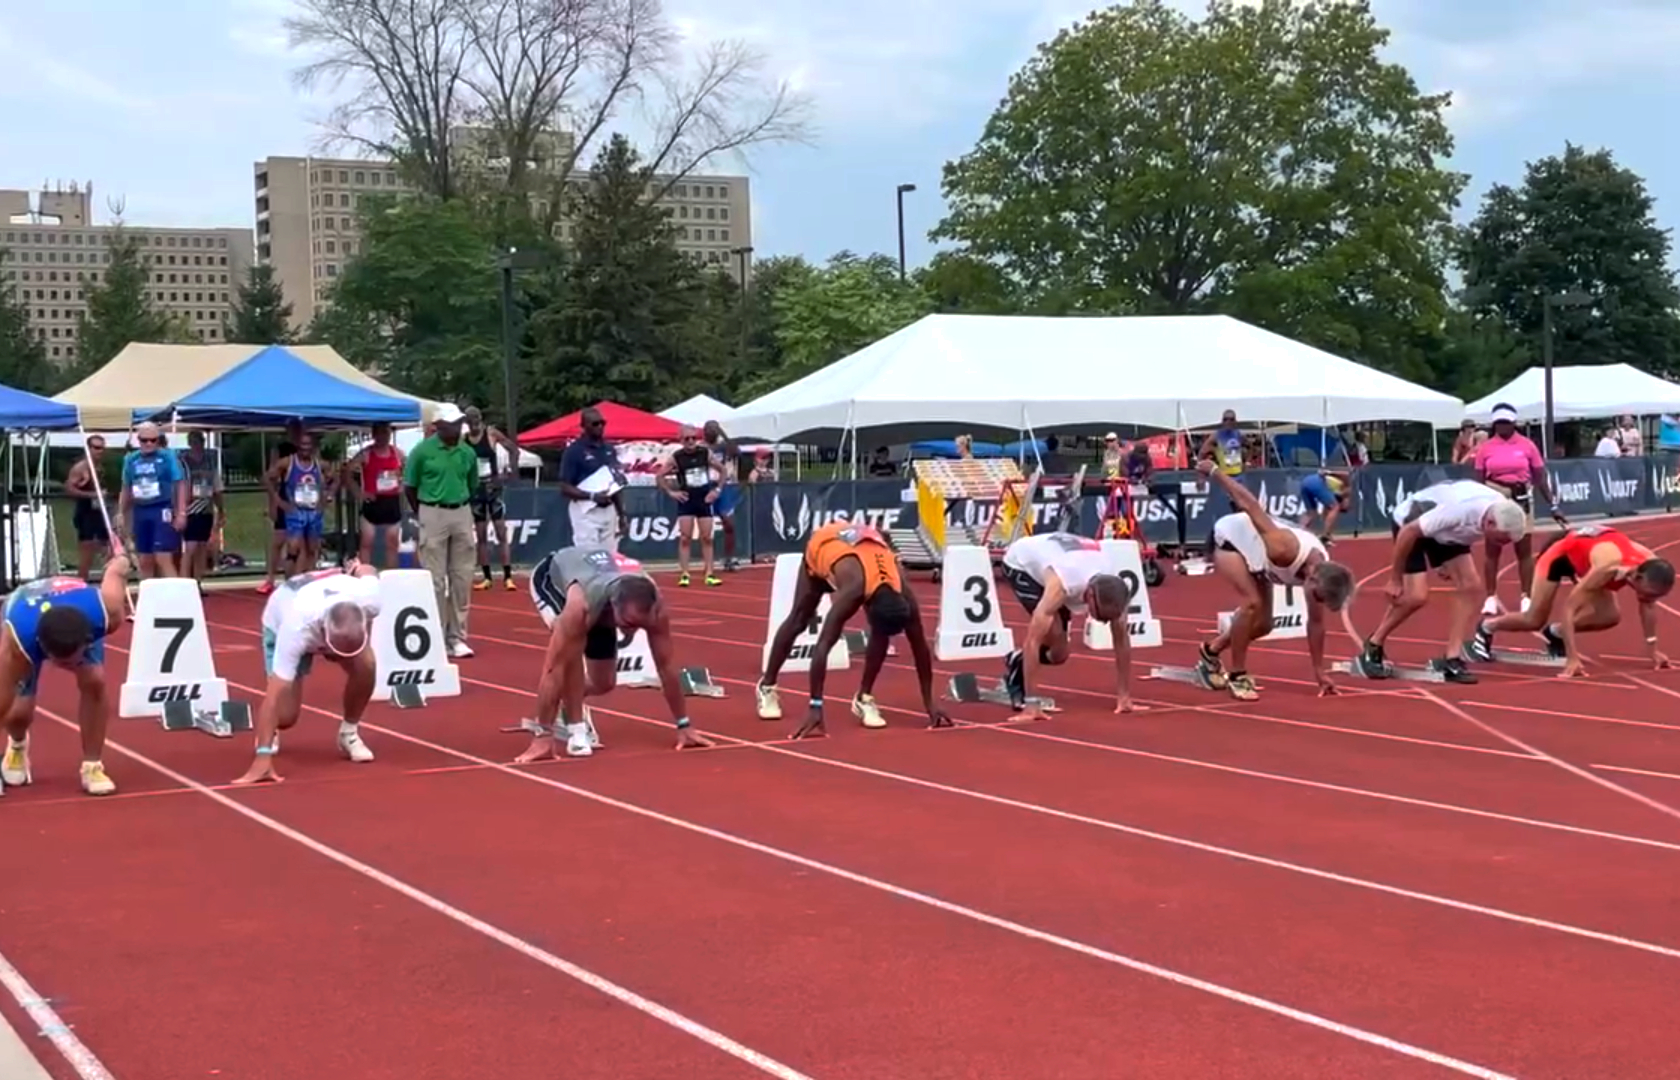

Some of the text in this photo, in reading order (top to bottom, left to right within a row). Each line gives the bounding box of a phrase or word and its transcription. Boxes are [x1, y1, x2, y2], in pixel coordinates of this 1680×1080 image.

[963, 574, 992, 624] 3
[393, 605, 431, 662] 6
[961, 631, 998, 648] GILL
[153, 617, 194, 674] 7
[616, 655, 644, 673] ILL
[386, 668, 436, 687] GILL
[148, 683, 202, 704] GILL
